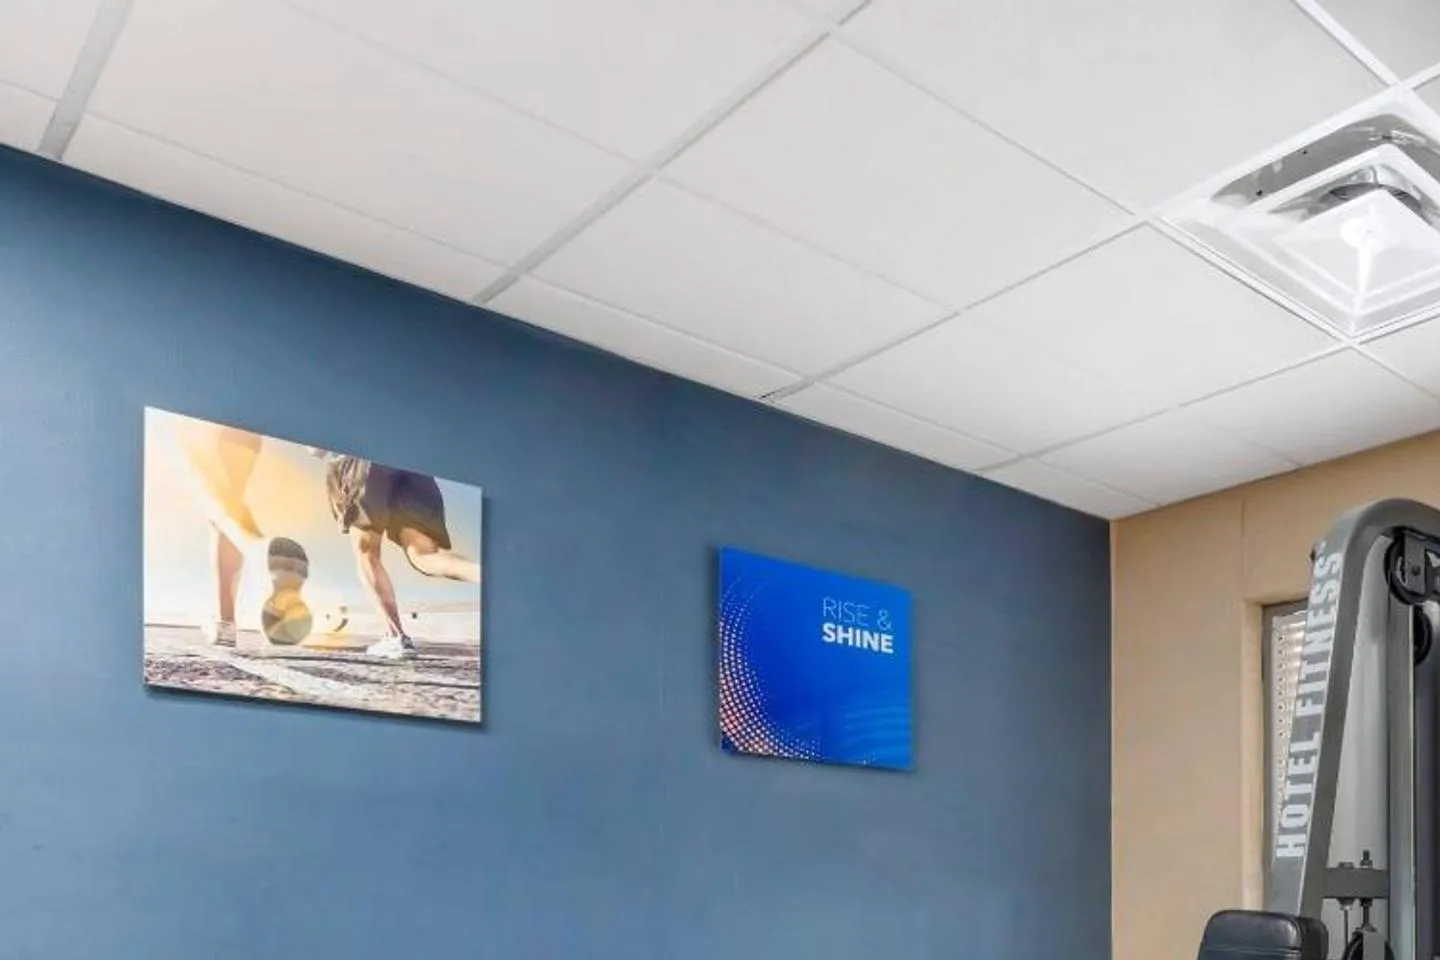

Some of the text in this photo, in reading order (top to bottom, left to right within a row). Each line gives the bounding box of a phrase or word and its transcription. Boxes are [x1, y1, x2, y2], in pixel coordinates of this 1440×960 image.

[823, 597, 893, 632] RISE &
[822, 622, 894, 654] SHINE
[1276, 552, 1344, 857] HOTEL FITNESS
